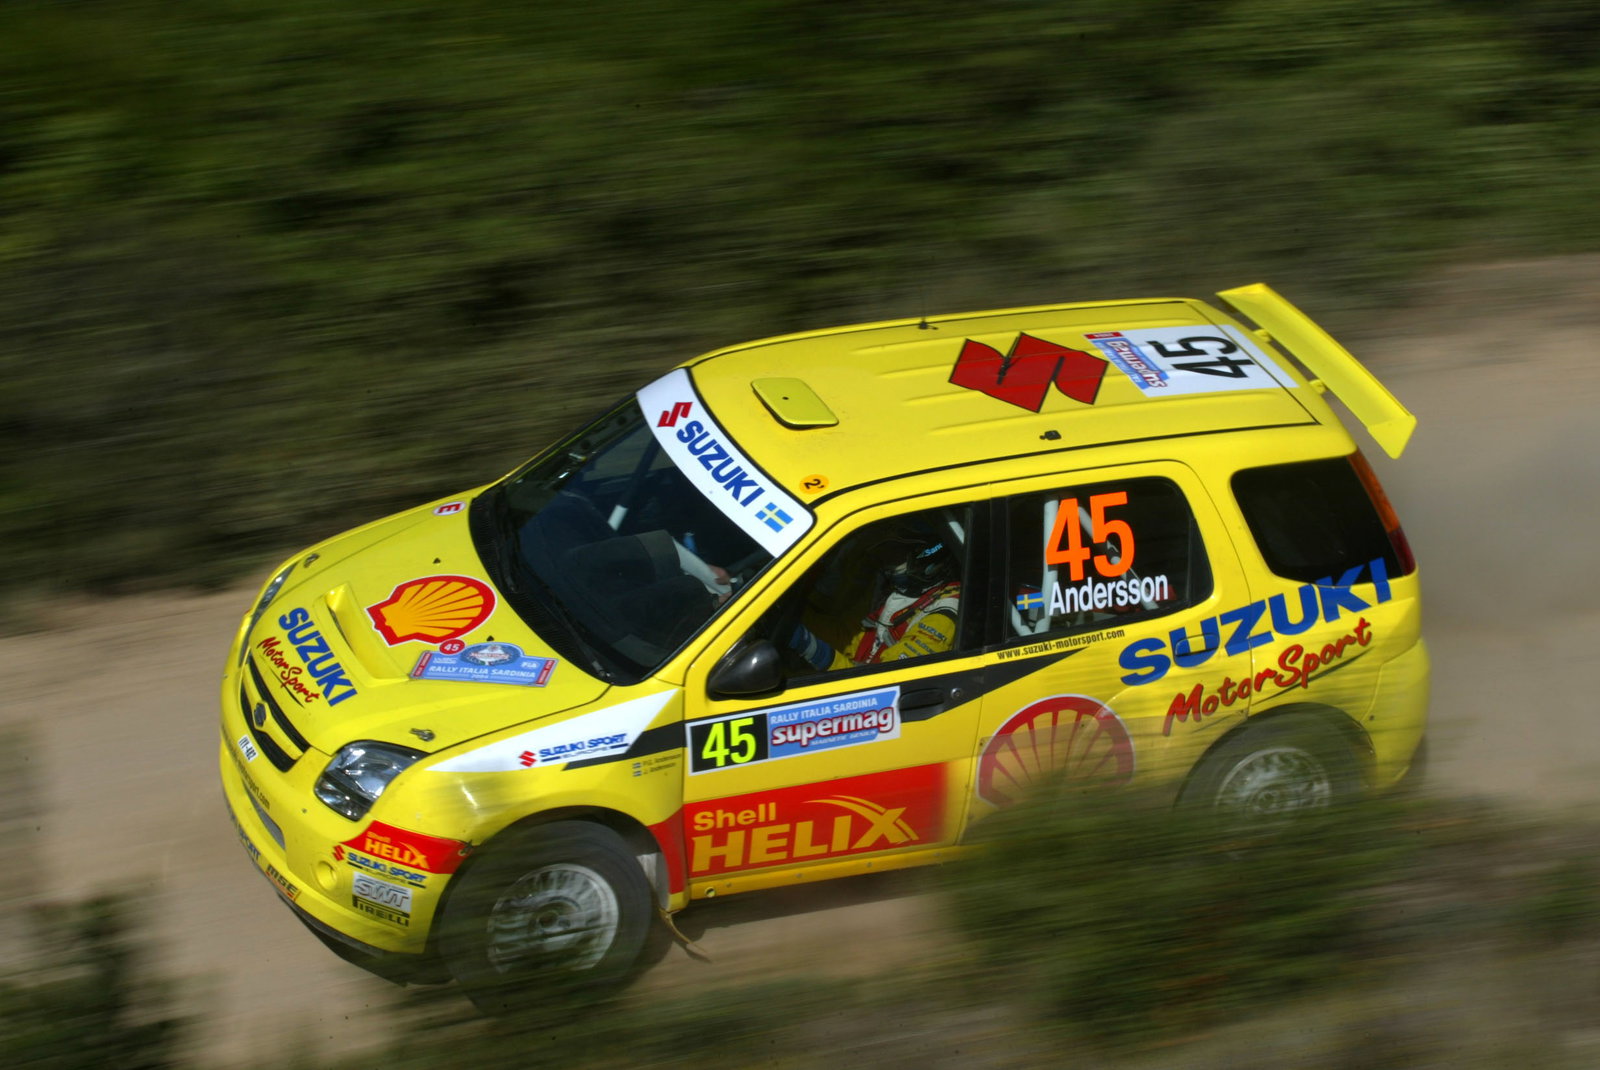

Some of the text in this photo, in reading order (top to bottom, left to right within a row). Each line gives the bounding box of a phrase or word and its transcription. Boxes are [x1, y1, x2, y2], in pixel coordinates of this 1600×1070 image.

[1146, 336, 1255, 378] 45
[676, 420, 766, 508] SUZUKI
[1045, 491, 1135, 582] 45
[1049, 574, 1168, 616] Andersson
[1118, 556, 1392, 686] SUZUKI
[278, 607, 358, 707] SUZUKI
[443, 643, 460, 652] 45
[997, 628, 1125, 660] www.suzuki-motorsport.com
[428, 665, 536, 678] RALLY ITALIA SARDINIA
[770, 697, 878, 724] RALLY ITALIA SARDINIA
[771, 707, 895, 748] supermag
[539, 733, 628, 758] SUZUKI SPORT
[702, 718, 757, 767] 45
[690, 796, 920, 874] HELIX
[693, 802, 777, 831] Shell
[347, 852, 387, 872] SUZUKI
[389, 867, 428, 882] SPORT
[364, 837, 430, 869] HELIX
[352, 895, 411, 928] PIRELLI
